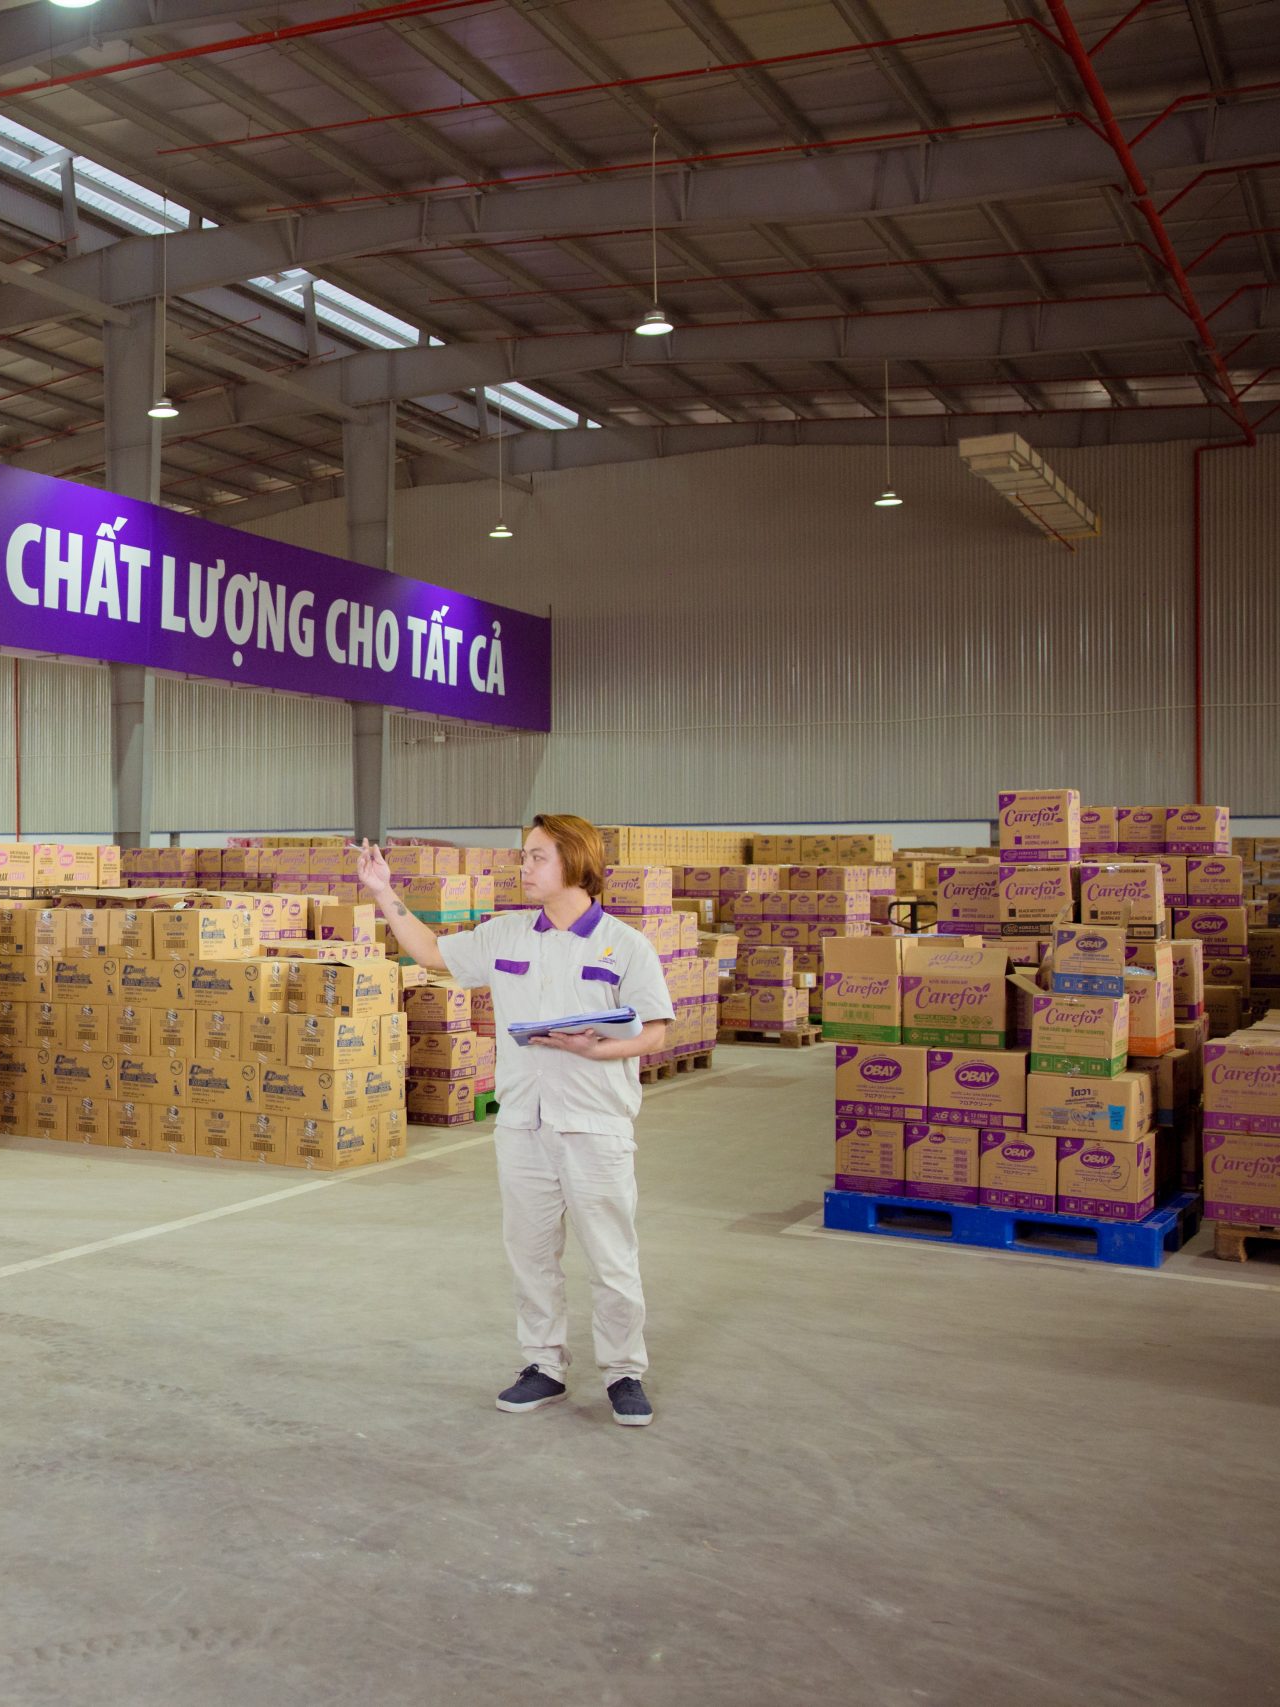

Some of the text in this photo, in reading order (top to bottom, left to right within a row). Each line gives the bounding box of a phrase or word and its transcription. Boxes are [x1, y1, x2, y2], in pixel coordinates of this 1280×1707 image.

[6, 516, 150, 623] CHẤT
[161, 556, 314, 666] LƯỢNG
[326, 598, 399, 672] CHO
[407, 605, 463, 686] TẤT
[469, 620, 505, 696] CẢ
[1004, 808, 1058, 826] Carefor
[943, 882, 996, 900] Carefor
[1006, 882, 1060, 900] Carefor
[1087, 882, 1146, 902] Carefor
[836, 980, 887, 1000] Carefor
[915, 985, 988, 1012] Carefor
[1045, 1008, 1102, 1028] Carefor
[863, 1065, 896, 1076] OBAY
[958, 1071, 994, 1082] OBAY
[1003, 1147, 1031, 1158] OBAY
[1082, 1154, 1110, 1165] OBAY
